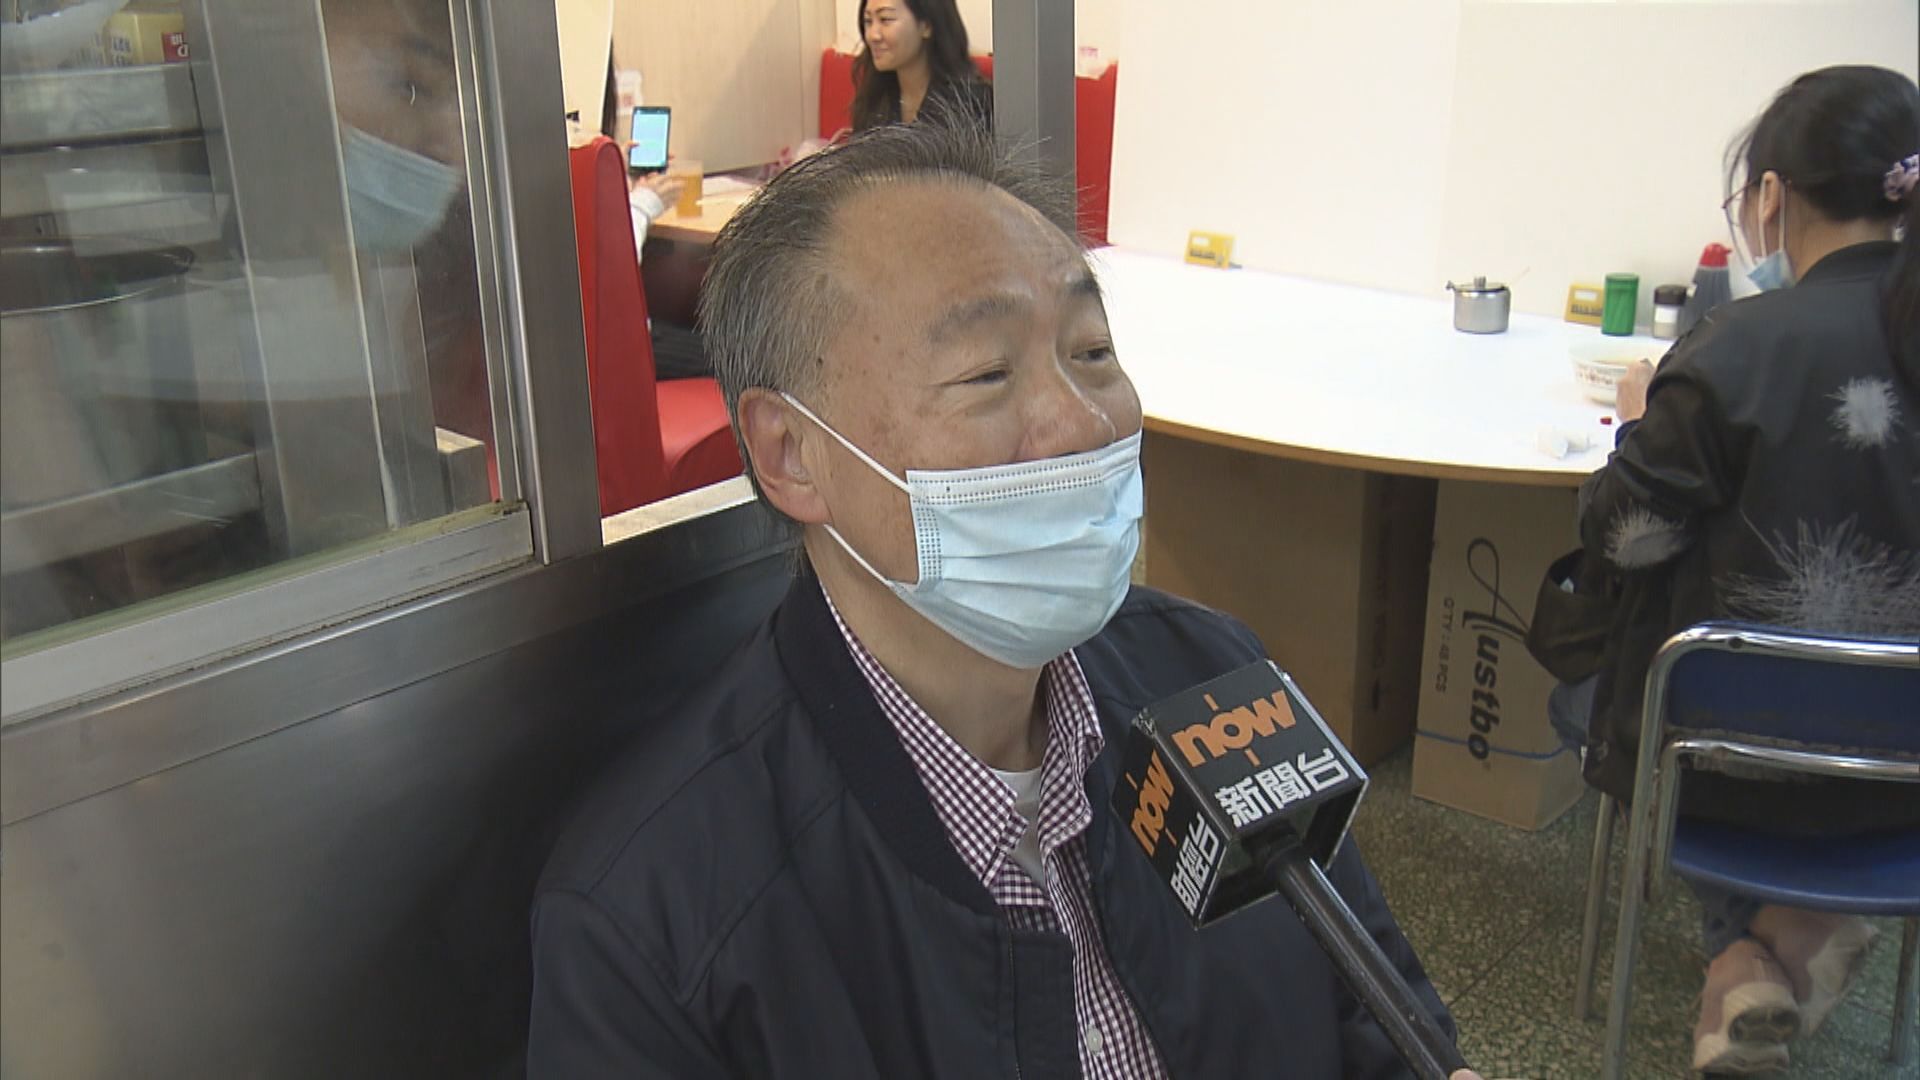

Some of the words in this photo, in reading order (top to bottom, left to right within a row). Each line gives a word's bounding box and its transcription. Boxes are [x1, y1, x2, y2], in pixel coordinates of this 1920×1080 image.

[1463, 537, 1530, 761] Austbo
[1172, 689, 1297, 768] now
[1130, 750, 1175, 858] now
[1215, 748, 1349, 828] 新聞台
[1170, 811, 1219, 916] 新聞台
